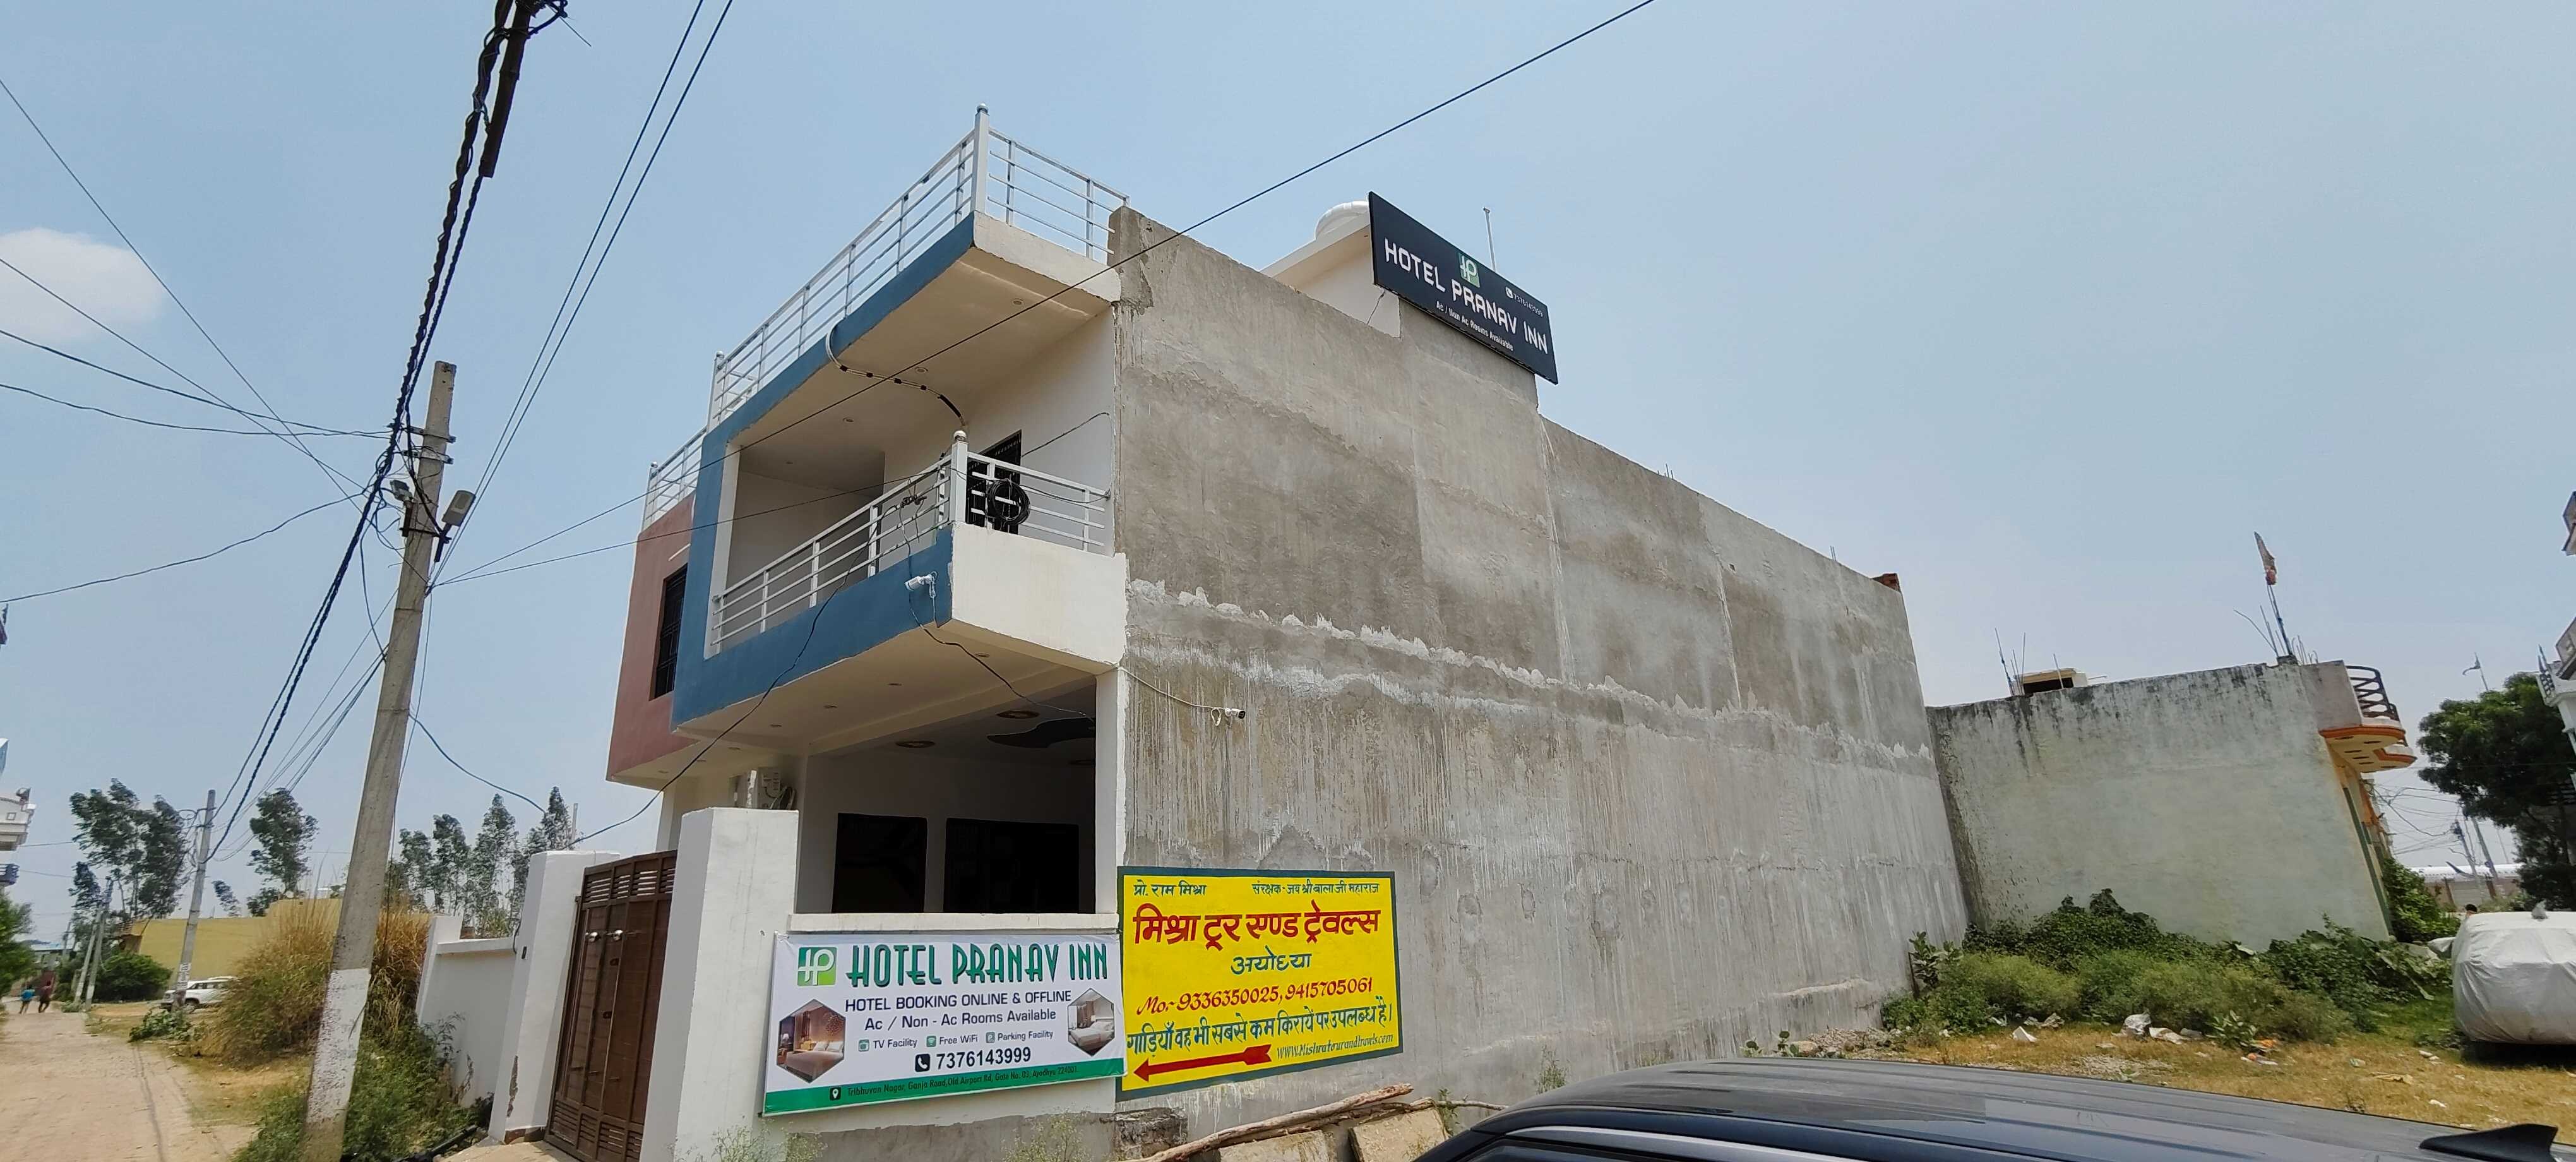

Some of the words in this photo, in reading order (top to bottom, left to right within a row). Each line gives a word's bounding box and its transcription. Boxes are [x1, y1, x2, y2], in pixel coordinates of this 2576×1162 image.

[1384, 237, 1446, 292] HOTEL
[1451, 279, 1517, 334] PRANAV
[1523, 321, 1548, 354] INN
[1436, 301, 1444, 311] Ac
[1462, 316, 1469, 326] Ac
[1470, 320, 1489, 336] Rooms
[1489, 330, 1513, 350] Available
[1151, 884, 1176, 897] राम
[1178, 880, 1207, 895] मिश्रा
[1349, 883, 1379, 895] महाराज
[1133, 902, 1201, 945] मिश्रा
[1304, 899, 1381, 943] ट्रेवल्स
[846, 944, 942, 987] HOTEL
[952, 943, 1059, 983] PRANAV
[1069, 943, 1108, 980] INN
[1231, 945, 1311, 975] अयोध्या
[845, 997, 891, 1012] HOTEL
[895, 995, 957, 1009] BOOKING
[962, 992, 1008, 1006] ONLINE
[1012, 992, 1021, 1004] &
[1025, 990, 1071, 1002] OFFLINE
[865, 1017, 883, 1031] Ac
[902, 1015, 928, 1027] Non
[941, 1014, 958, 1026] Ac
[962, 1012, 1003, 1025] Rooms
[1007, 1009, 1056, 1022] Available
[1193, 1016, 1210, 1045] भी
[1212, 1012, 1248, 1043] सबसे
[1250, 1017, 1275, 1039] कम
[873, 1040, 885, 1048] TV
[888, 1038, 917, 1049] Facility
[939, 1036, 957, 1045] Free
[960, 1034, 979, 1043] WiFi
[997, 1032, 1026, 1042] Parking
[1029, 1030, 1053, 1040] Facility
[936, 1046, 1032, 1069] 7376143999
